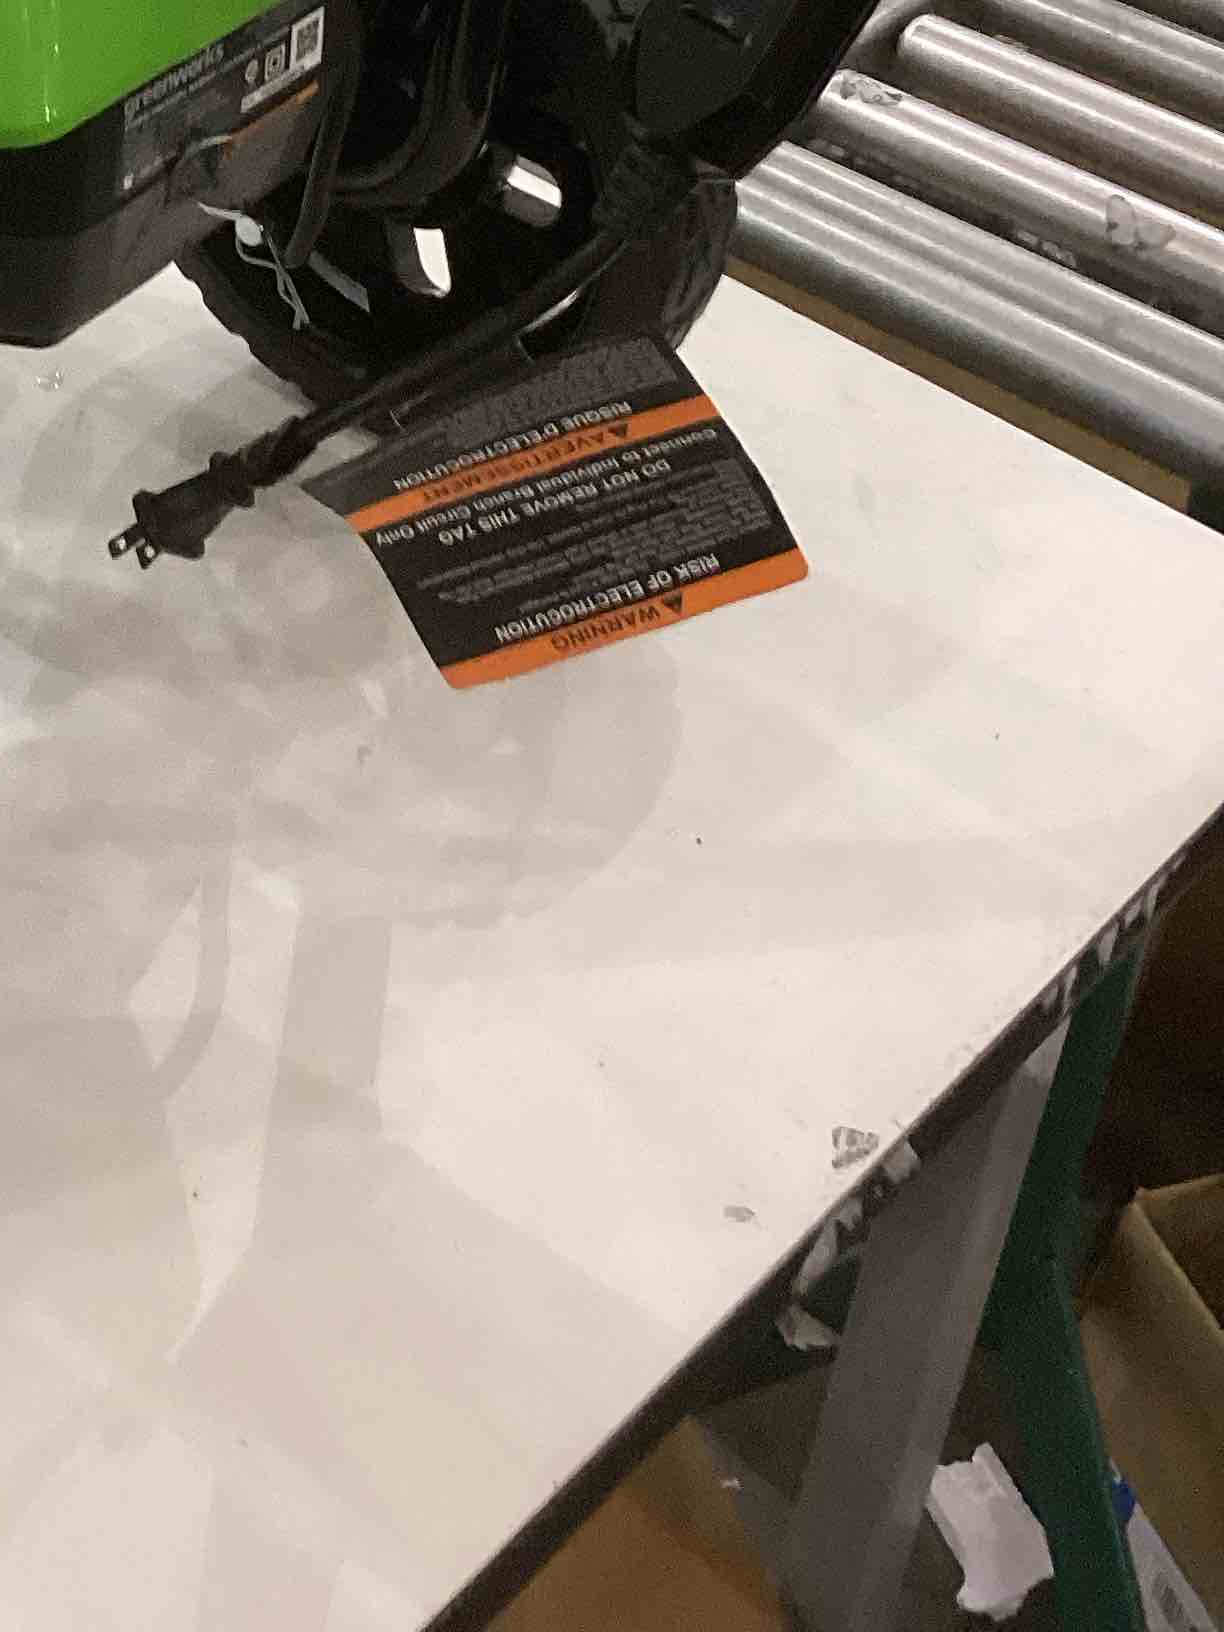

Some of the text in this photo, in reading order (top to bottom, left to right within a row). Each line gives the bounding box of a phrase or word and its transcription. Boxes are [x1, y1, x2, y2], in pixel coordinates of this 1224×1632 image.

[560, 400, 633, 432] RISQUE
[376, 428, 717, 548] Connect to Individual Branch Circuit Only
[438, 458, 671, 546] DO NOT REMOVE THIS TAG
[647, 569, 672, 592] OF
[673, 552, 721, 581] RISK
[493, 578, 645, 644] ELECTROCUTION
[550, 604, 662, 652] WARNING
